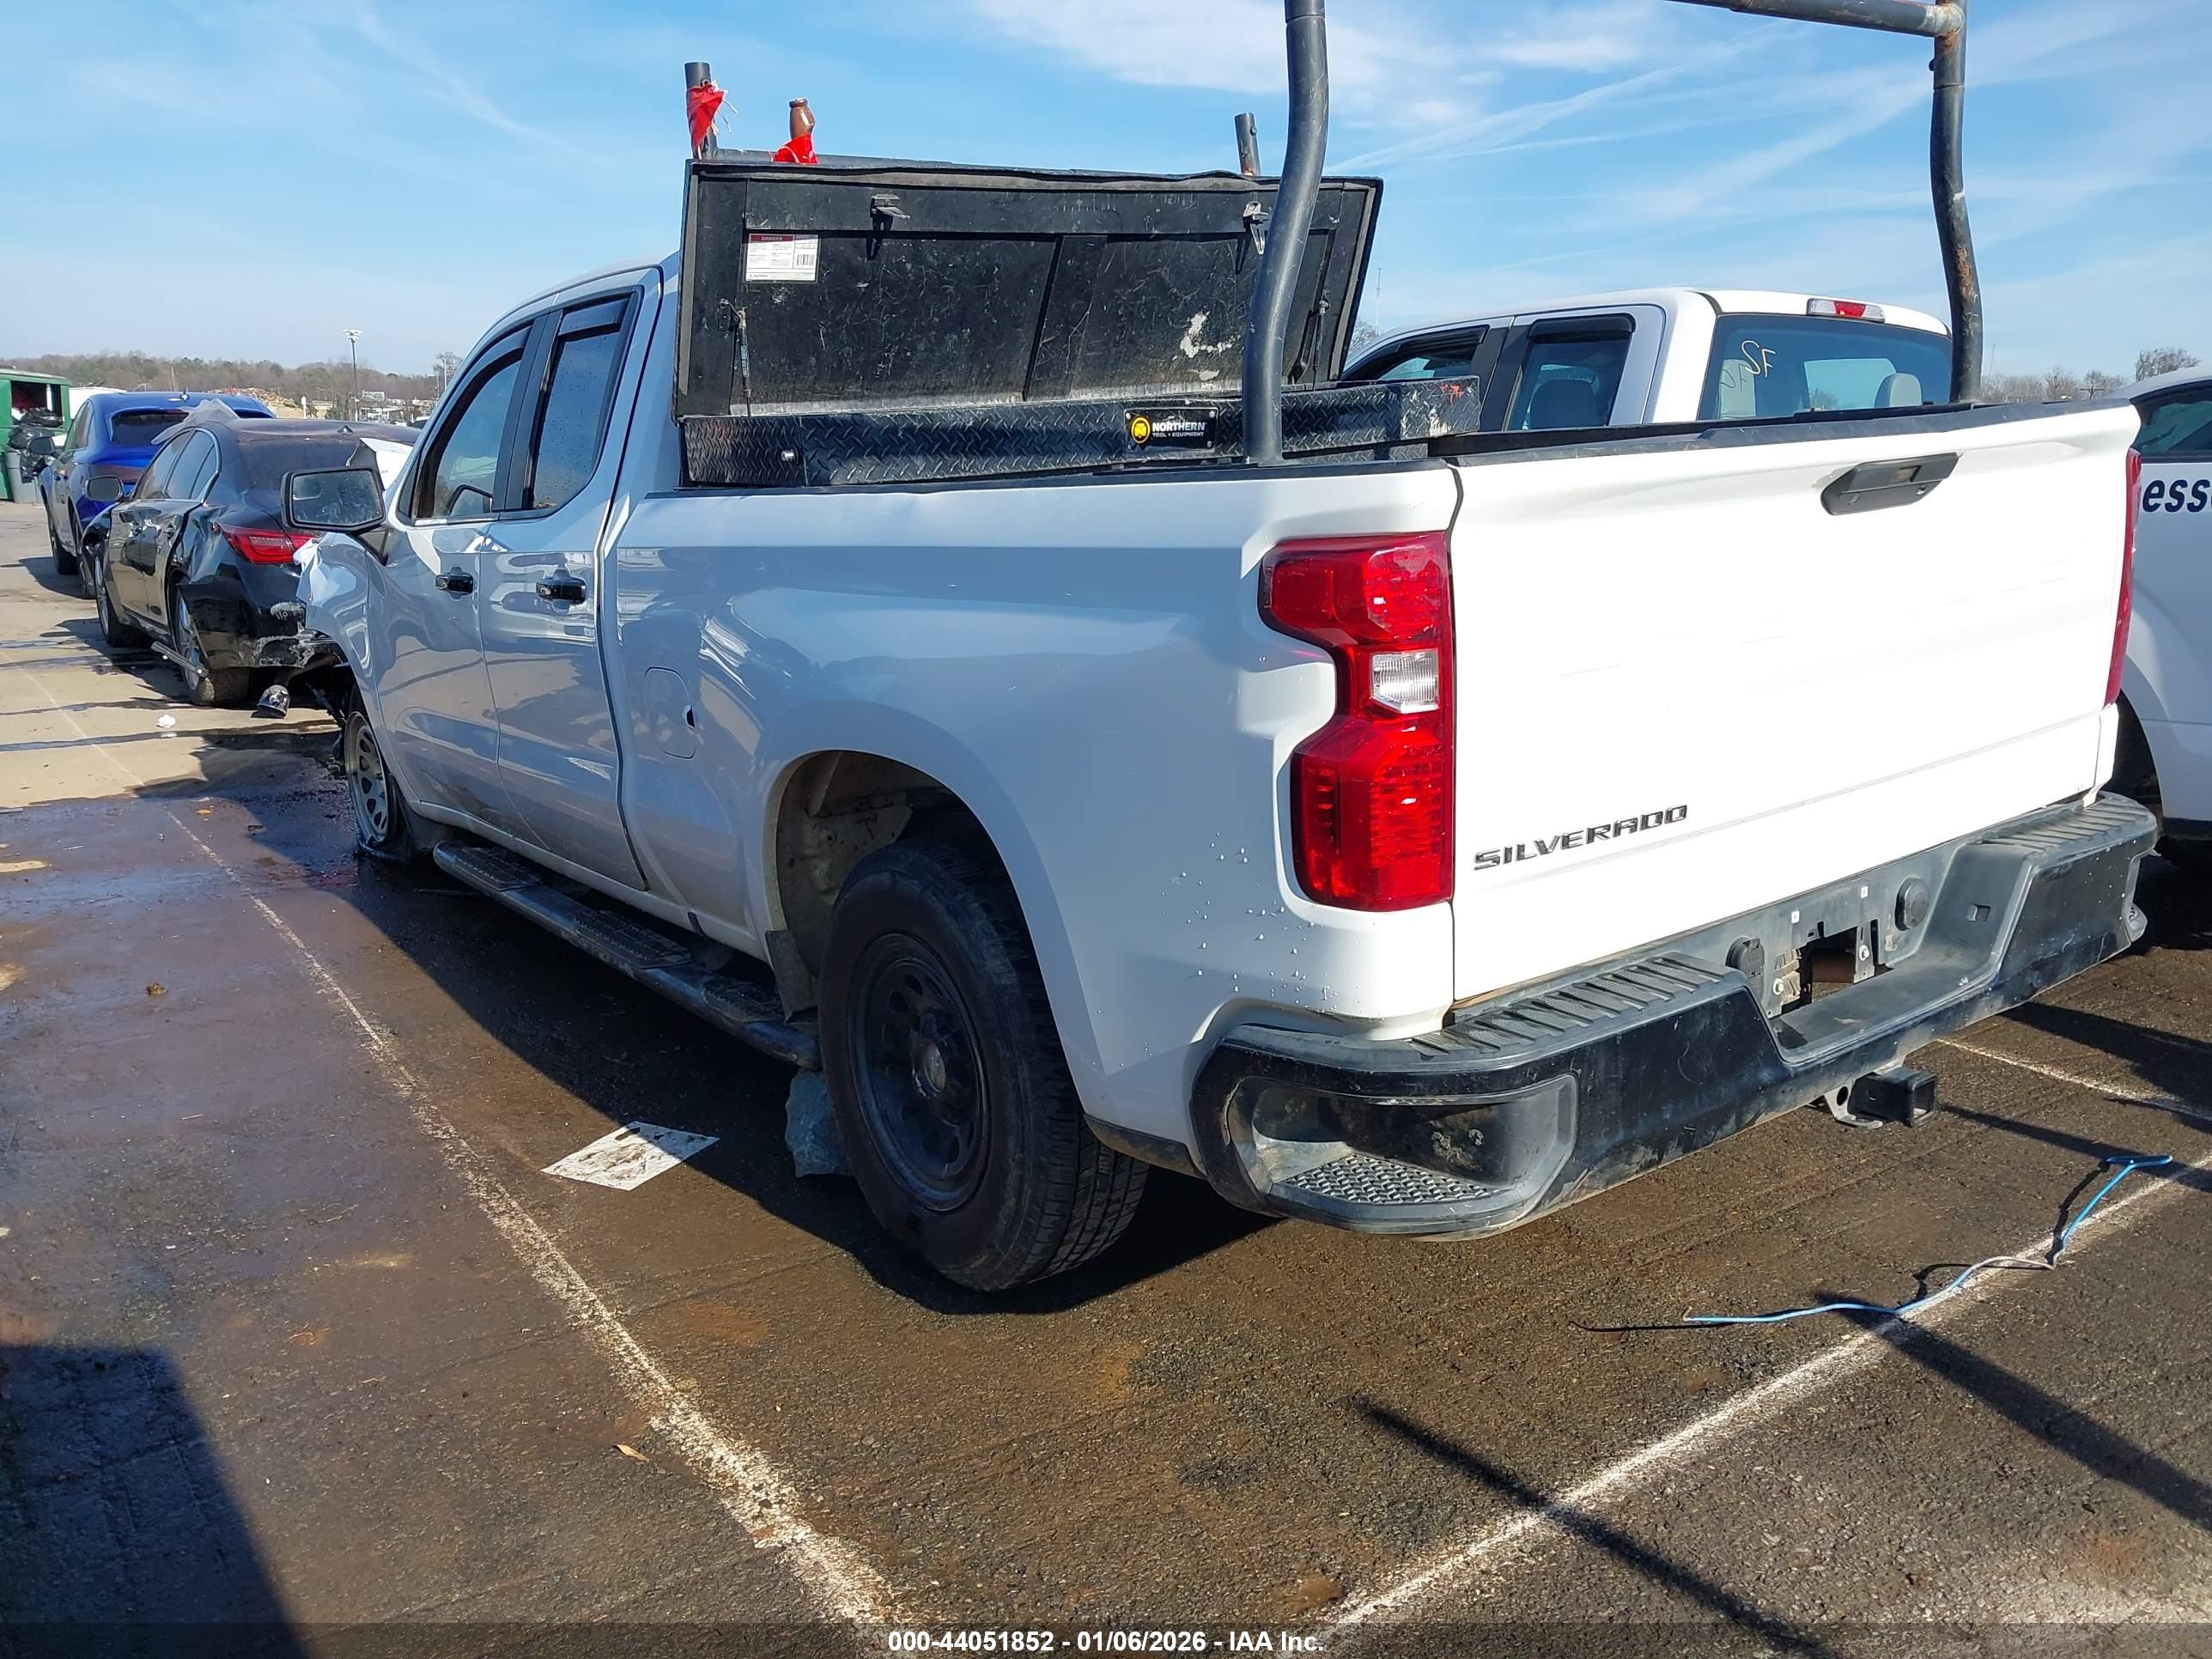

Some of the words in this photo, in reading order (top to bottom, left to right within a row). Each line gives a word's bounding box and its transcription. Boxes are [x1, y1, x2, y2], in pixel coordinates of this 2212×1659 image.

[1741, 340, 1777, 378] SF
[1152, 422, 1206, 432] NORTHERN
[2142, 479, 2212, 513] ess
[1474, 805, 1687, 871] SILVERADO
